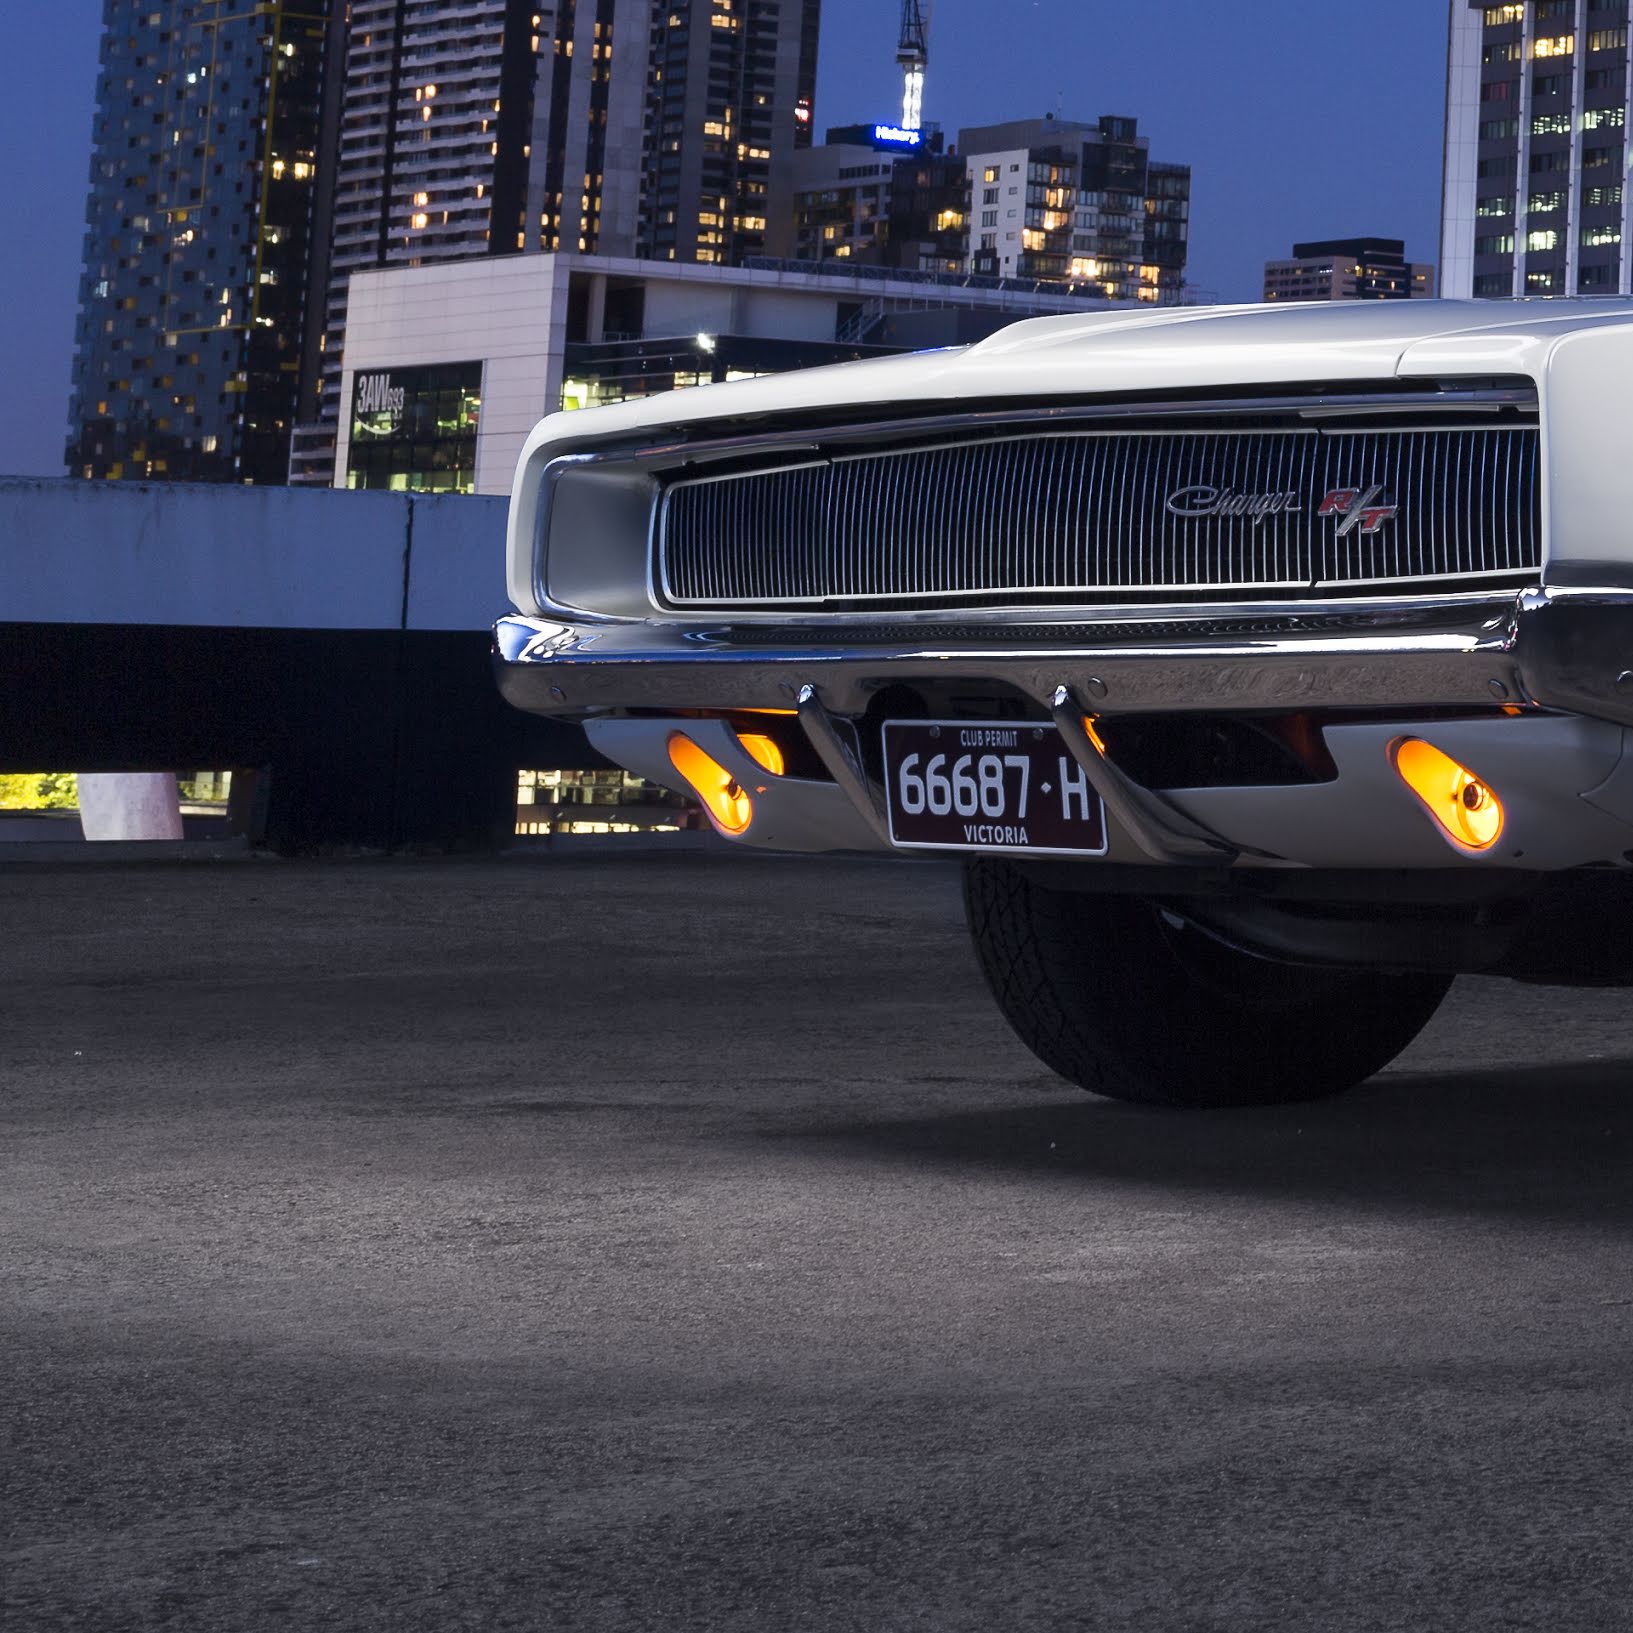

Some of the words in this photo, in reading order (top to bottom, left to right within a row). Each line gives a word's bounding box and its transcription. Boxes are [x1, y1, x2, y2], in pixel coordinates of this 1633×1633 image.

[1166, 485, 1301, 525] Charger
[1318, 484, 1400, 536] R/T
[960, 730, 983, 747] CLUB
[985, 730, 1017, 747] PERMIT
[964, 825, 1028, 844] VICTORIA
